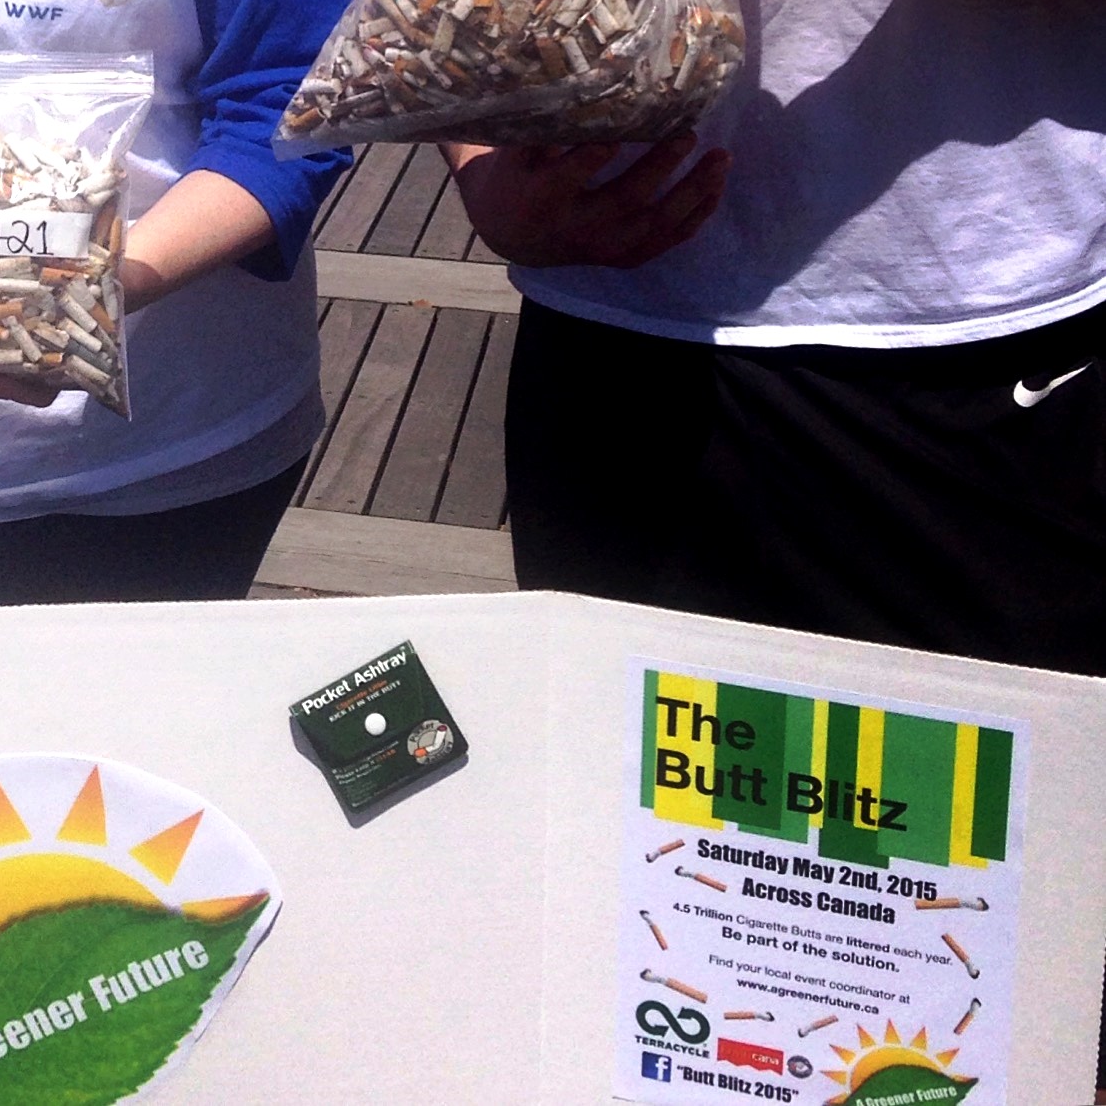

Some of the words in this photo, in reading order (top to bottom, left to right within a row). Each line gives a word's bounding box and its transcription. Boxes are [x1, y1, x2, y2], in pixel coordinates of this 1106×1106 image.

[5, 1, 64, 22] WWF
[301, 679, 352, 715] Pocket
[354, 651, 406, 687] Ashtray
[655, 696, 755, 751] The
[655, 748, 767, 807] Butt
[786, 771, 908, 832] Blitz
[697, 838, 789, 876] Saturday
[792, 856, 835, 884] May
[839, 866, 882, 893] 2nd,
[887, 874, 937, 901] 2015
[742, 877, 812, 908] Across
[817, 892, 896, 924] Canada
[673, 902, 691, 914] 4.5
[694, 905, 733, 922] Trillion
[736, 914, 788, 933] Cigarette
[791, 925, 822, 940] Butts
[825, 934, 843, 944] are
[846, 936, 890, 953] littered
[894, 947, 922, 959] each
[722, 926, 742, 941] Be
[746, 933, 778, 949] part
[782, 940, 799, 953] of
[802, 943, 827, 958] the
[832, 950, 900, 973] solution.
[88, 940, 209, 1012] Future
[709, 954, 733, 968] Find
[736, 963, 761, 974] your
[764, 967, 791, 981] local
[794, 974, 826, 987] event
[829, 980, 896, 1001] coordinator
[899, 993, 910, 1004] at
[737, 978, 880, 1014] www.agreenerfuture.ca
[635, 1035, 710, 1058] TERRACYCLE
[718, 1074, 751, 1095] Blitz
[866, 1092, 915, 1106] Greener
[916, 1086, 957, 1102] Future
